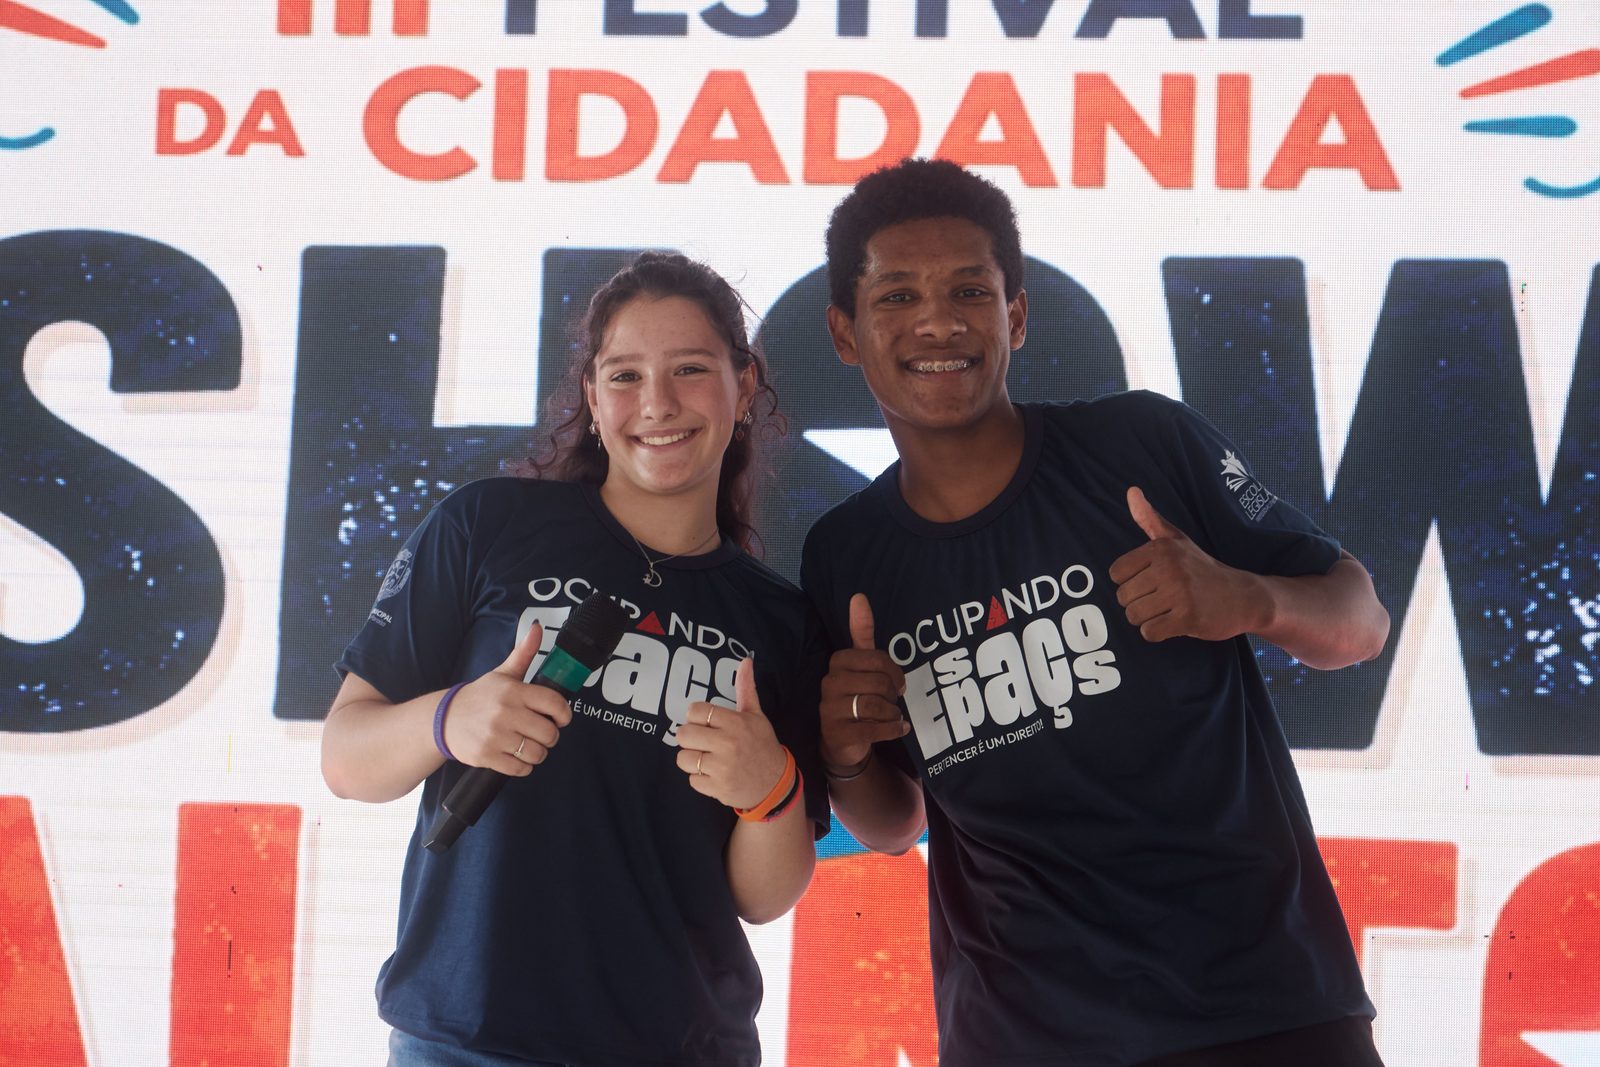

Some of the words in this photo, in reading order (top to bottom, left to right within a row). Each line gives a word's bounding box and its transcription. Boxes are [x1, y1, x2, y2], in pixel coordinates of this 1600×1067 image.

[155, 88, 306, 157] DA
[363, 65, 1402, 191] CIDADANIA
[1239, 482, 1263, 509] ESCOL
[1245, 488, 1273, 521] LEGISLA
[528, 577, 755, 660] OCPANDO
[888, 564, 1095, 666] OCUPANDO
[573, 698, 582, 713] É
[583, 703, 602, 719] UM
[603, 710, 657, 736] DIREITO!
[927, 746, 978, 778] PERTENCER
[978, 739, 986, 753] É
[986, 736, 1006, 750] UM
[1006, 718, 1045, 744] DIREITO!
